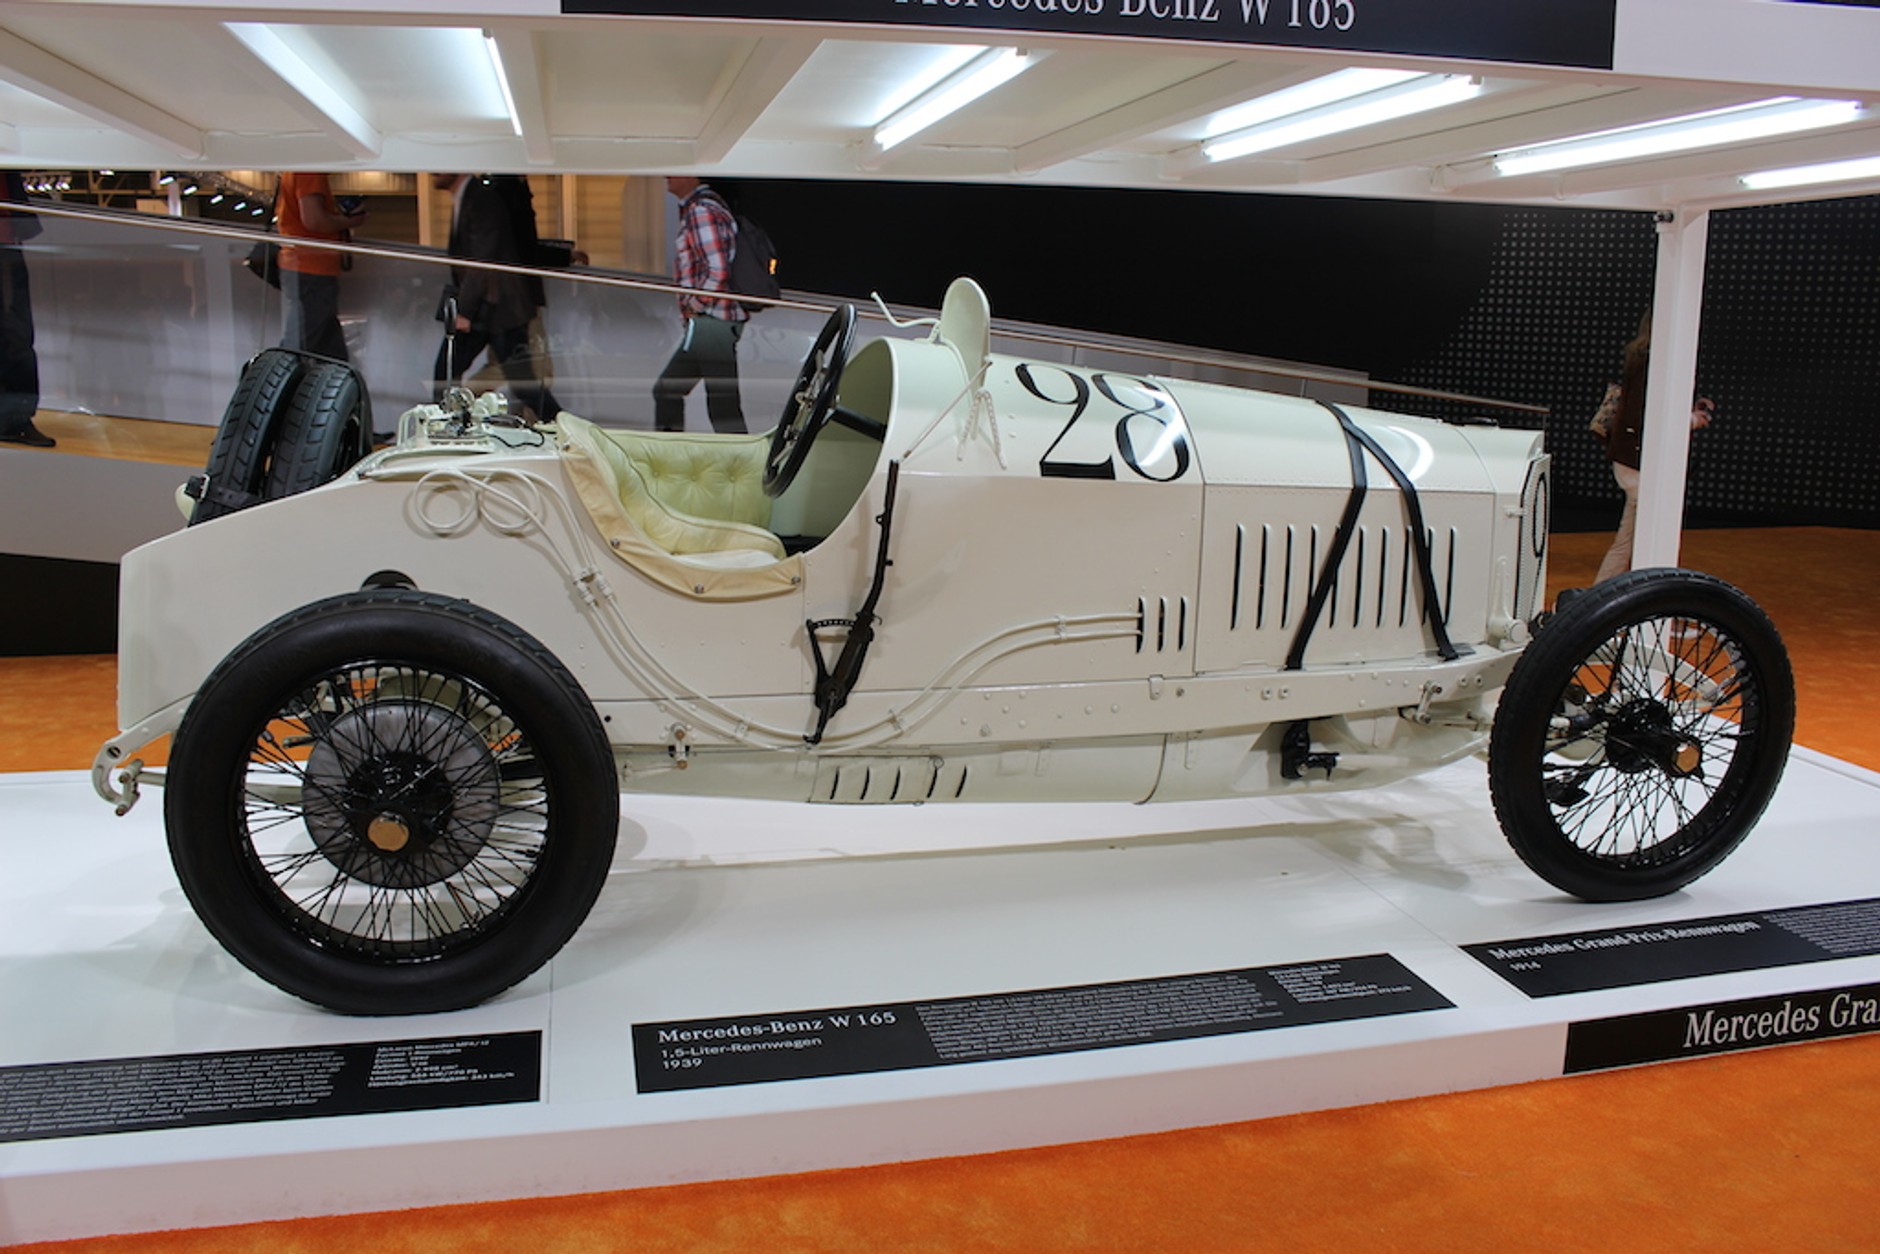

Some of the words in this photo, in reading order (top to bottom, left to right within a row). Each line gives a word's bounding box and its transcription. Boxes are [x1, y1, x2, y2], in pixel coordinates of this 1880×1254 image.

[1015, 362, 1190, 482] 28
[1489, 941, 1574, 960] Mercedes
[1510, 960, 1542, 972] 1914
[658, 1019, 823, 1043] Mercedes-Benz
[829, 1015, 850, 1028] W
[857, 1011, 897, 1026] 165
[1683, 1001, 1821, 1048] Mercedes
[1829, 993, 1880, 1028] Gra
[663, 1058, 702, 1070] 1939
